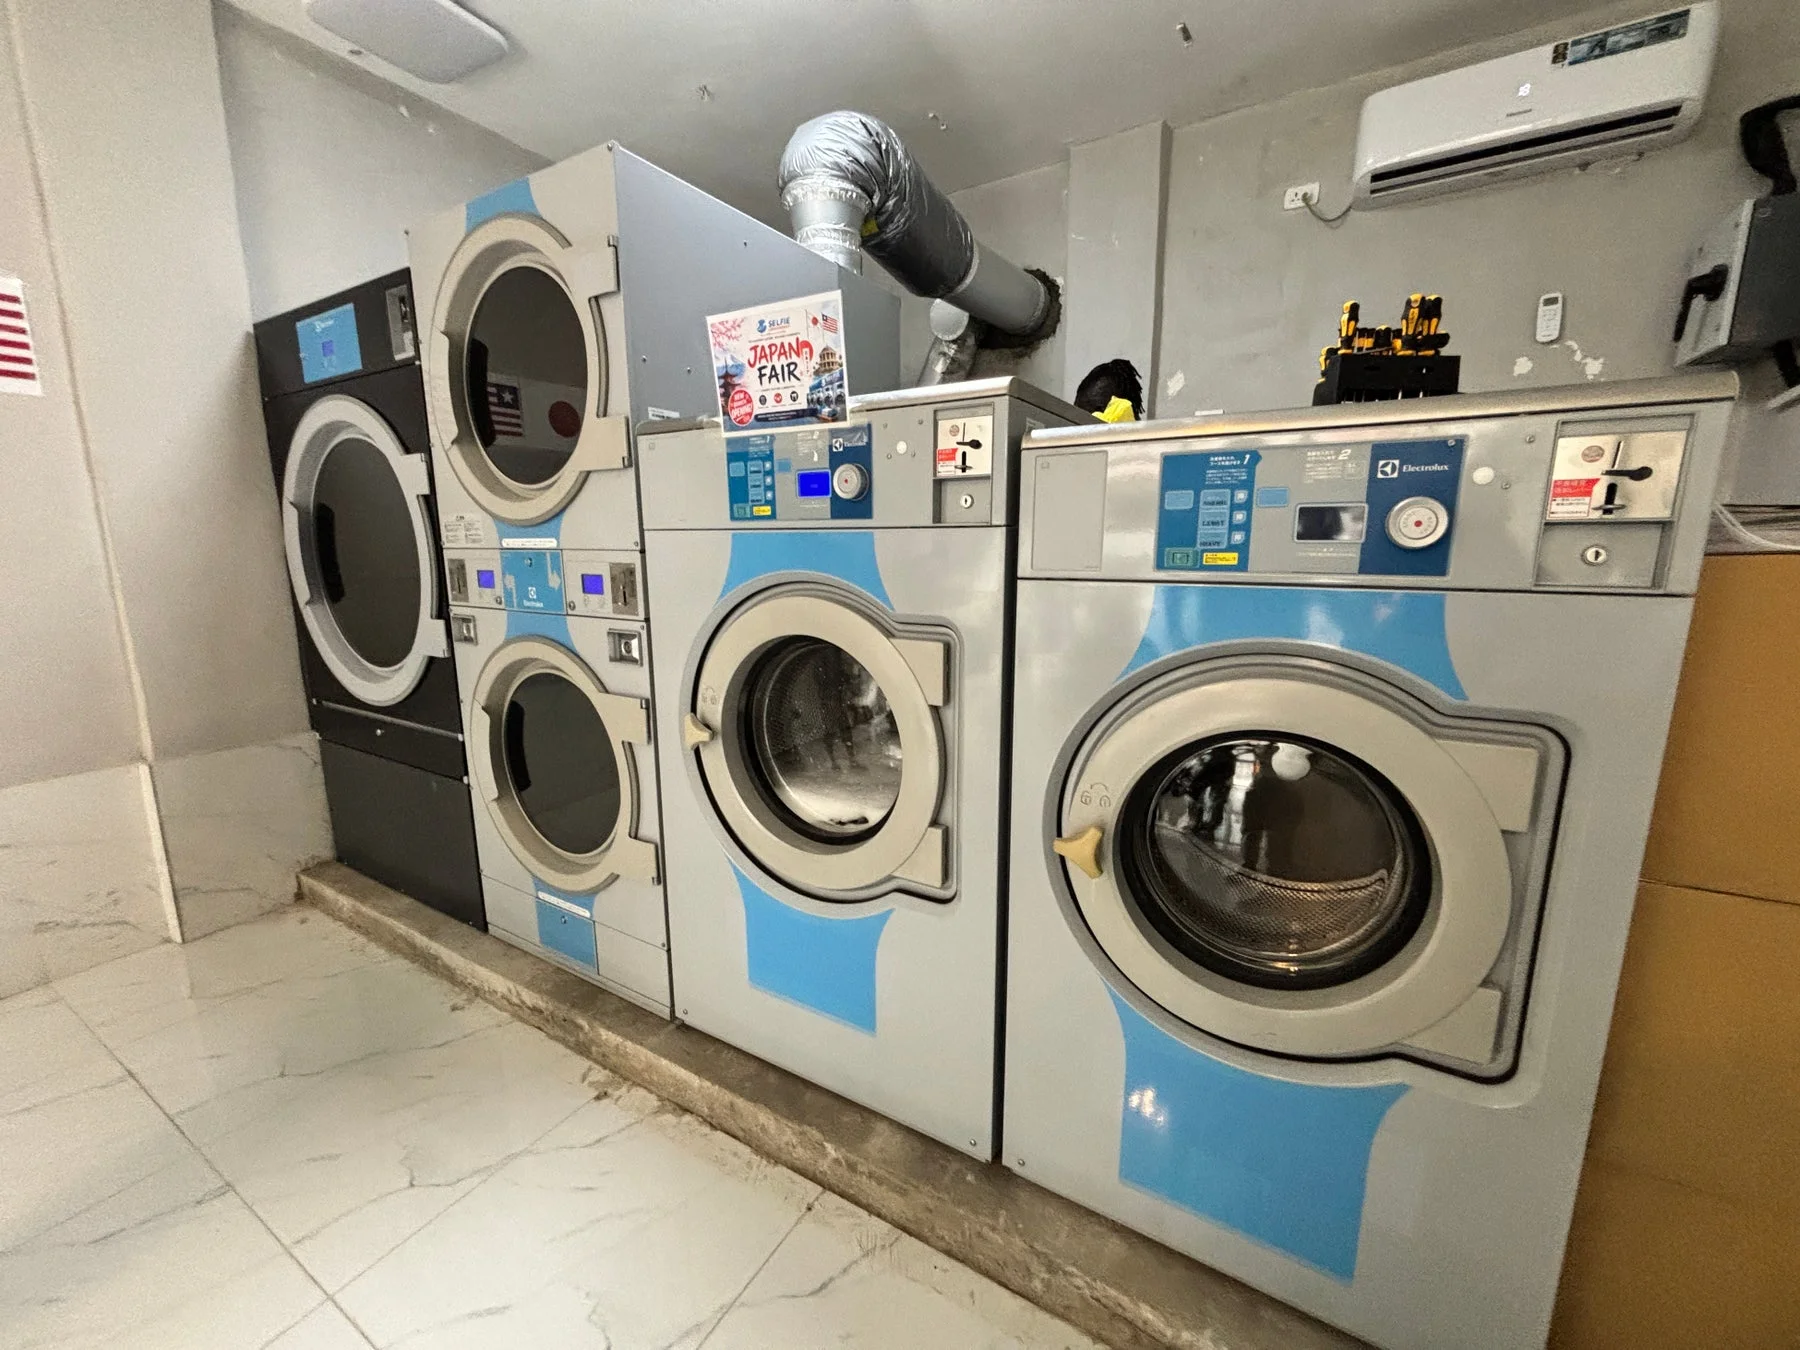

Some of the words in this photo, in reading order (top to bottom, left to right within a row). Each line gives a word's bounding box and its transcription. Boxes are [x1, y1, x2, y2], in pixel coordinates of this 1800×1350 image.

[768, 317, 790, 327] SELFIE
[748, 336, 801, 368] JAPAN
[757, 362, 801, 386] FAIR
[1243, 454, 1251, 465] 1
[1338, 449, 1352, 460] 2
[1402, 463, 1449, 472] Electrolux
